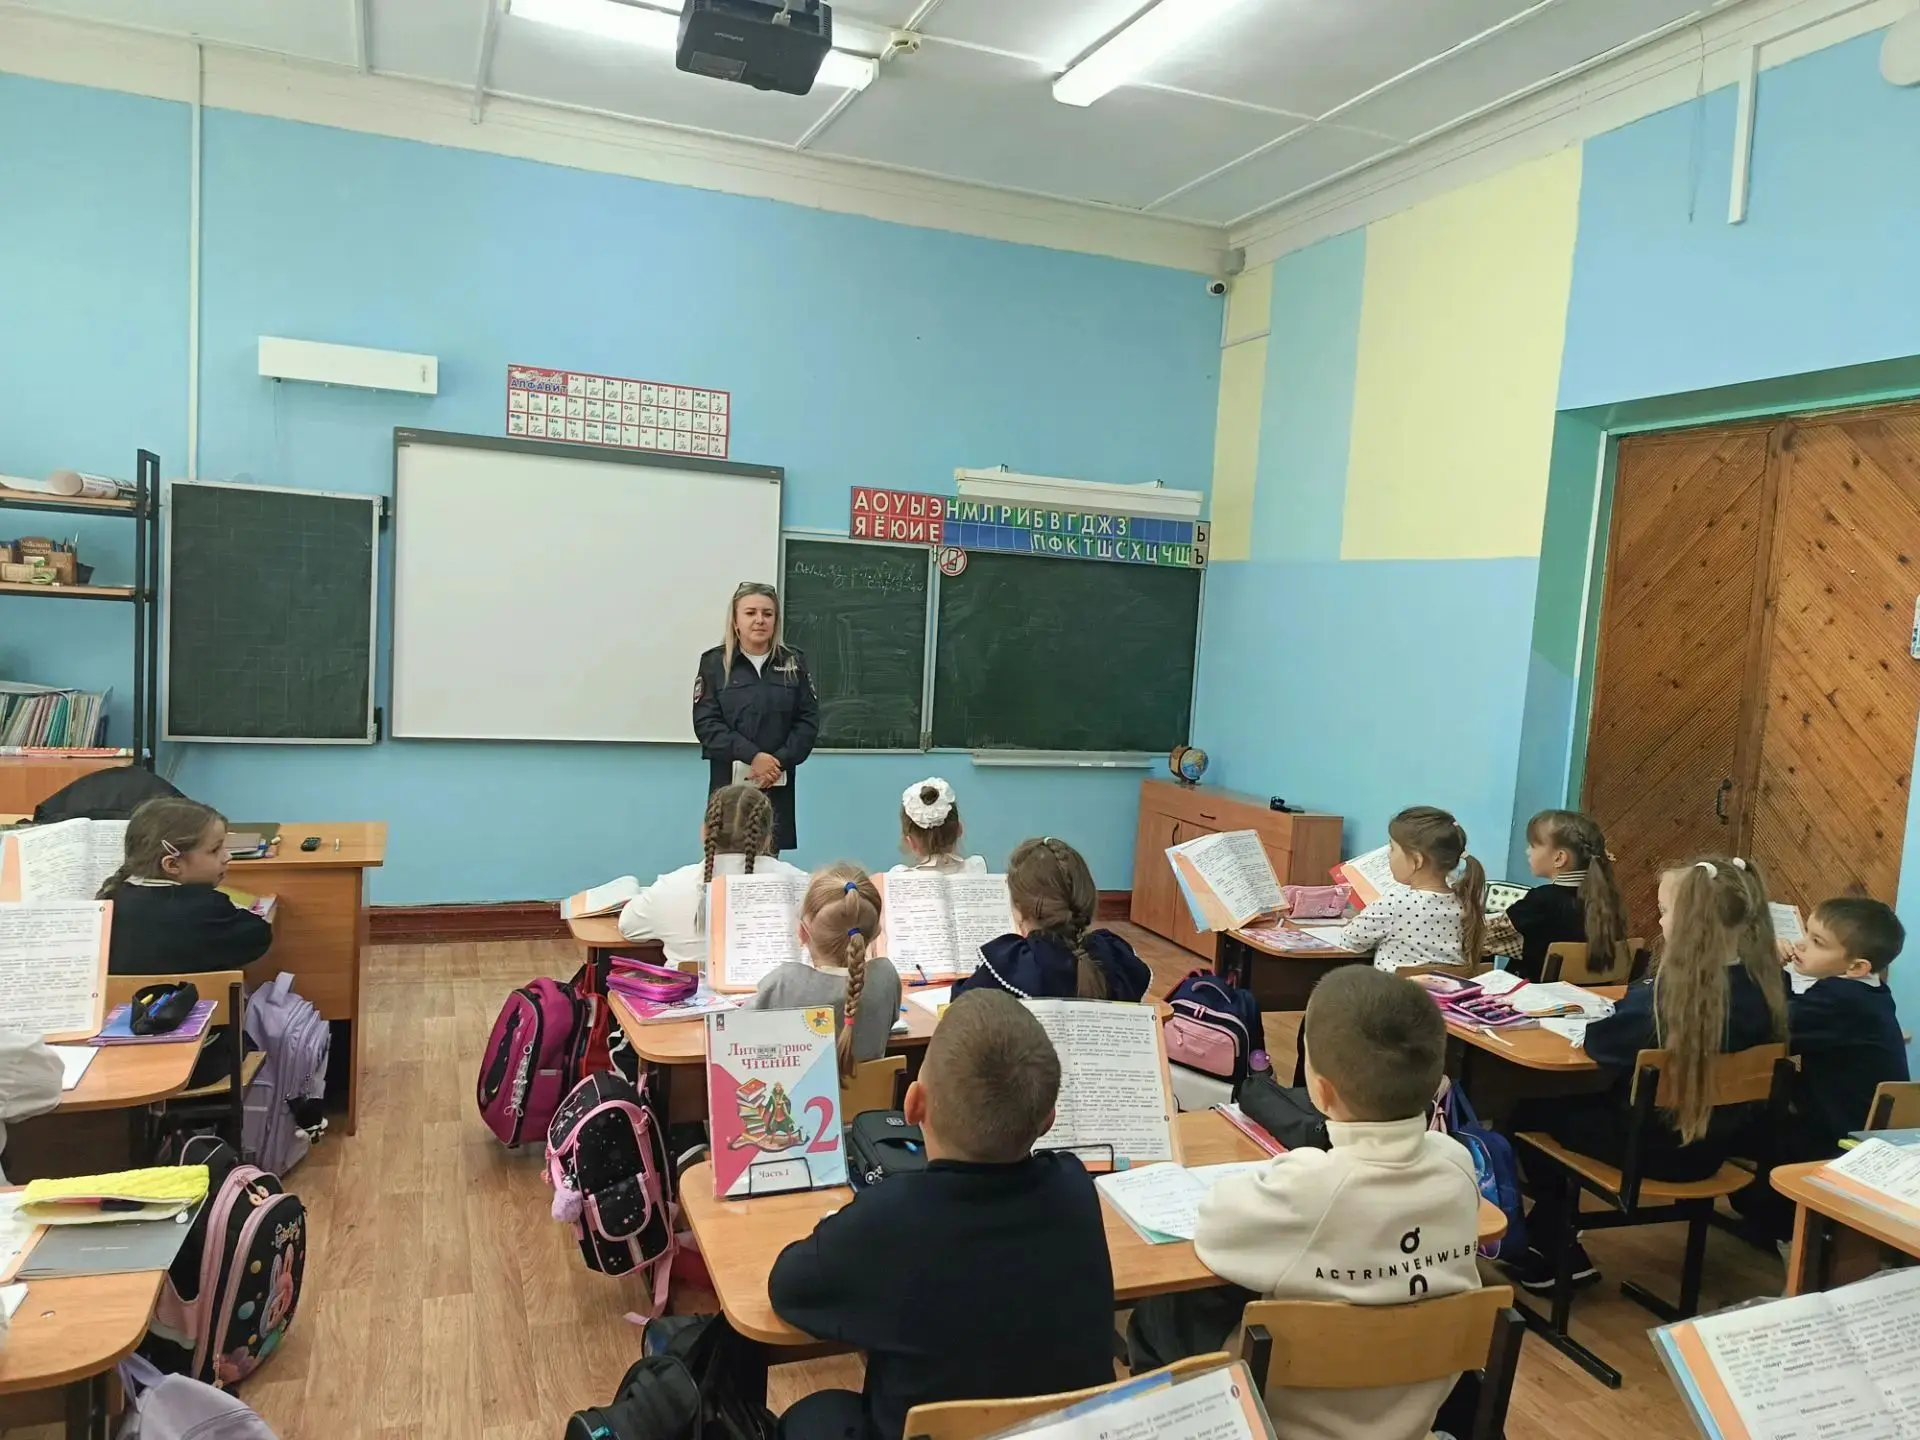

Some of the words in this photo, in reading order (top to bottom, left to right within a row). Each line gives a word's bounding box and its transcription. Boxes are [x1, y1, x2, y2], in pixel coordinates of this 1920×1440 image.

[854, 490, 942, 518] АОУЫЭ
[854, 516, 940, 542] ЯЁЮИЕ
[804, 1096, 839, 1153] 2
